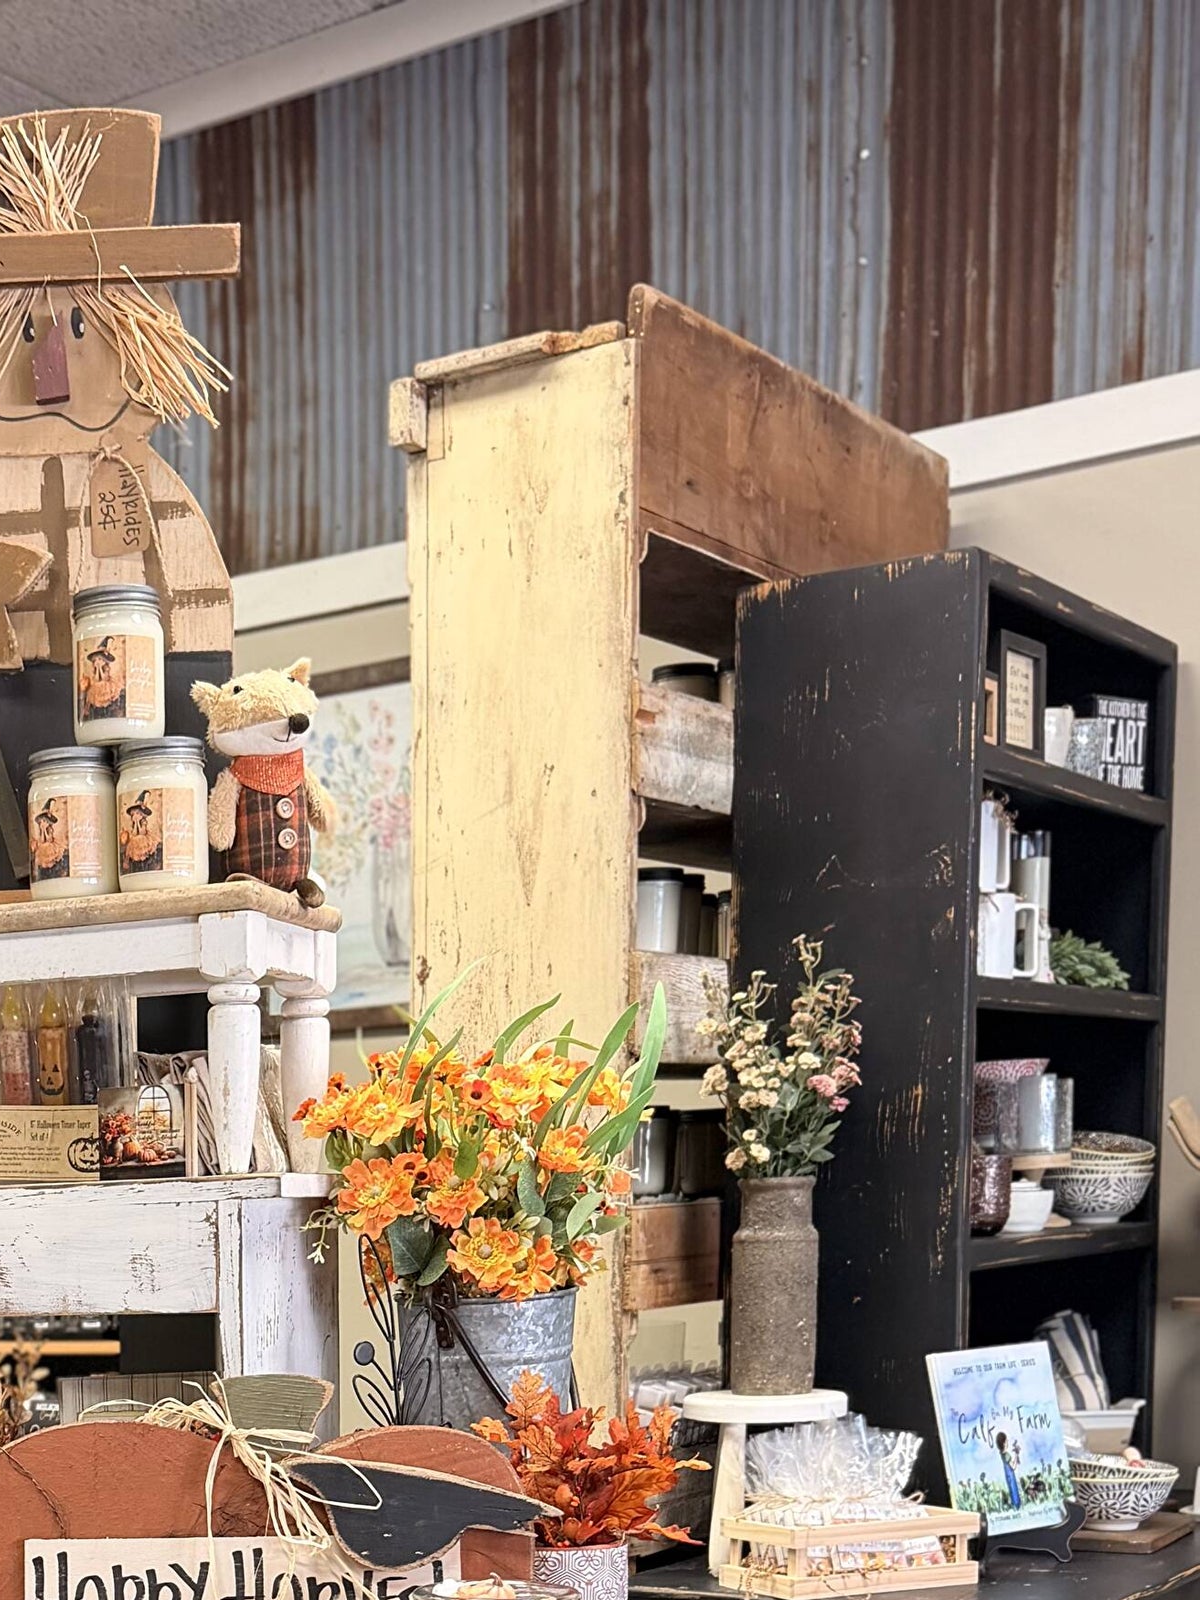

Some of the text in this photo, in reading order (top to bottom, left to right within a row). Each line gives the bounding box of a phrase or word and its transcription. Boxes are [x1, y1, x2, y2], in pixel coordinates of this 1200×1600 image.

[1122, 766, 1145, 791] HOME
[958, 1413, 996, 1449] Calf
[1016, 1405, 1052, 1434] Farm
